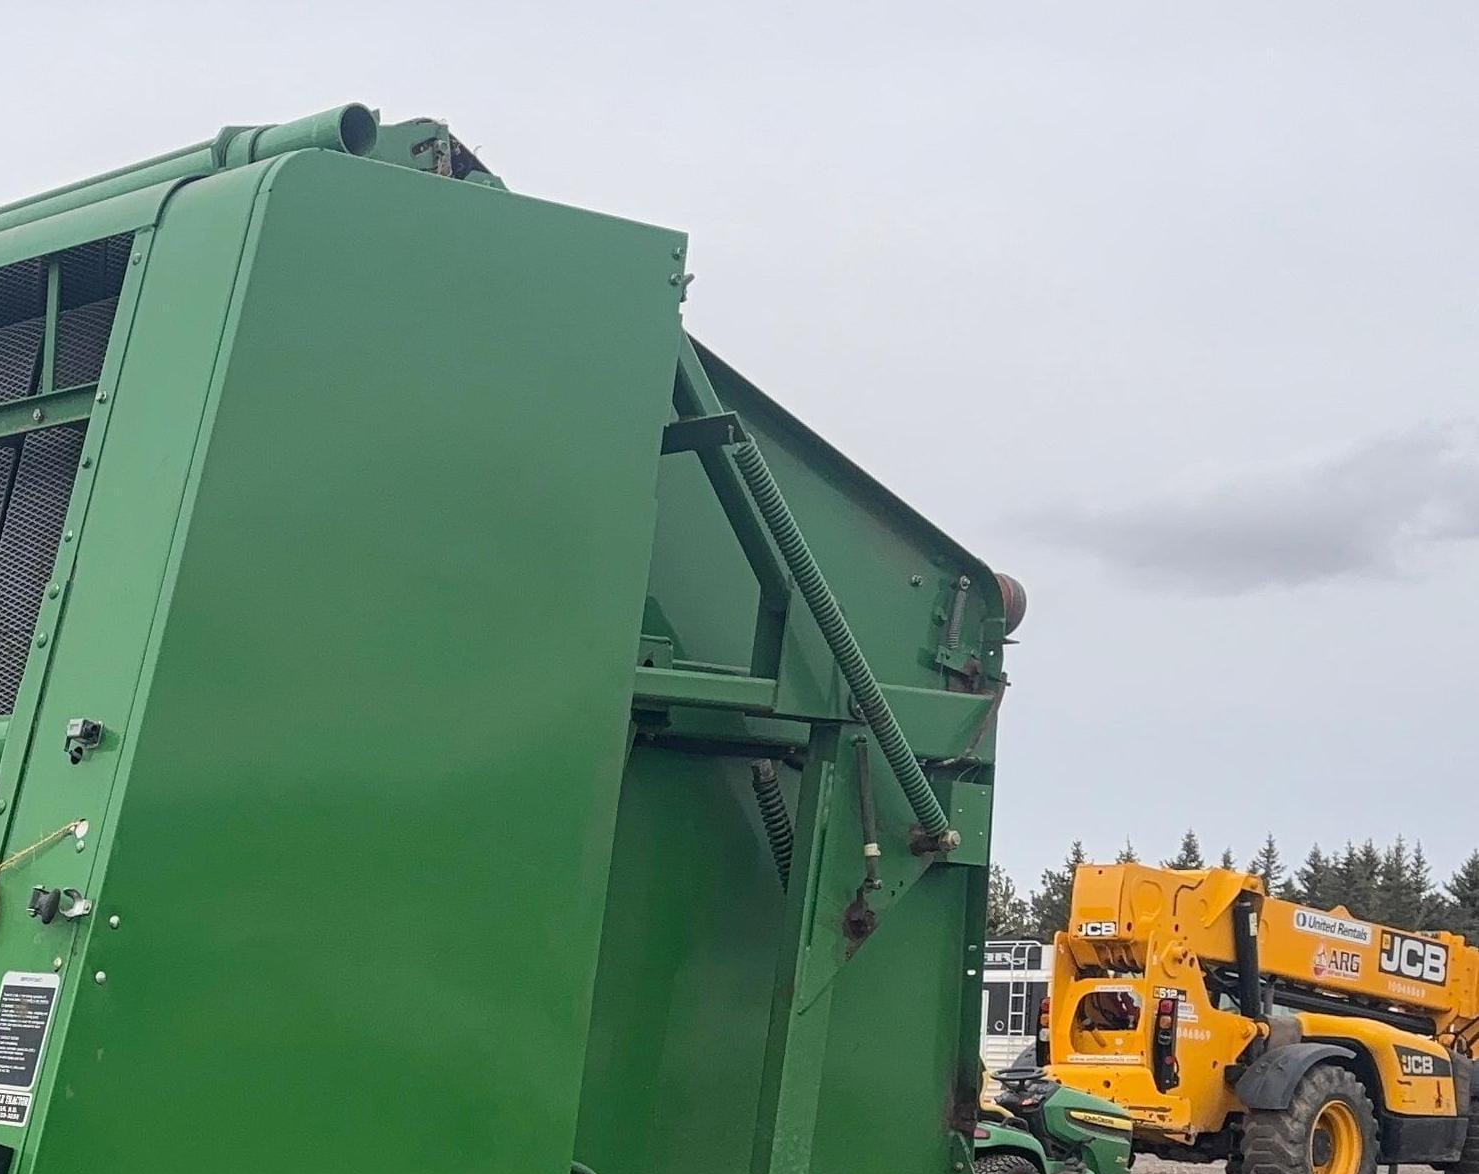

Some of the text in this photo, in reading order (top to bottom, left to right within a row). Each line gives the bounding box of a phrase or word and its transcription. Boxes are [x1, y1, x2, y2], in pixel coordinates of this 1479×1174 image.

[1078, 922, 1117, 936] JCB
[1307, 915, 1368, 942] United Rentals
[1328, 950, 1361, 974] ARG
[1381, 934, 1447, 983] JCB
[1402, 1055, 1434, 1074] JCB
